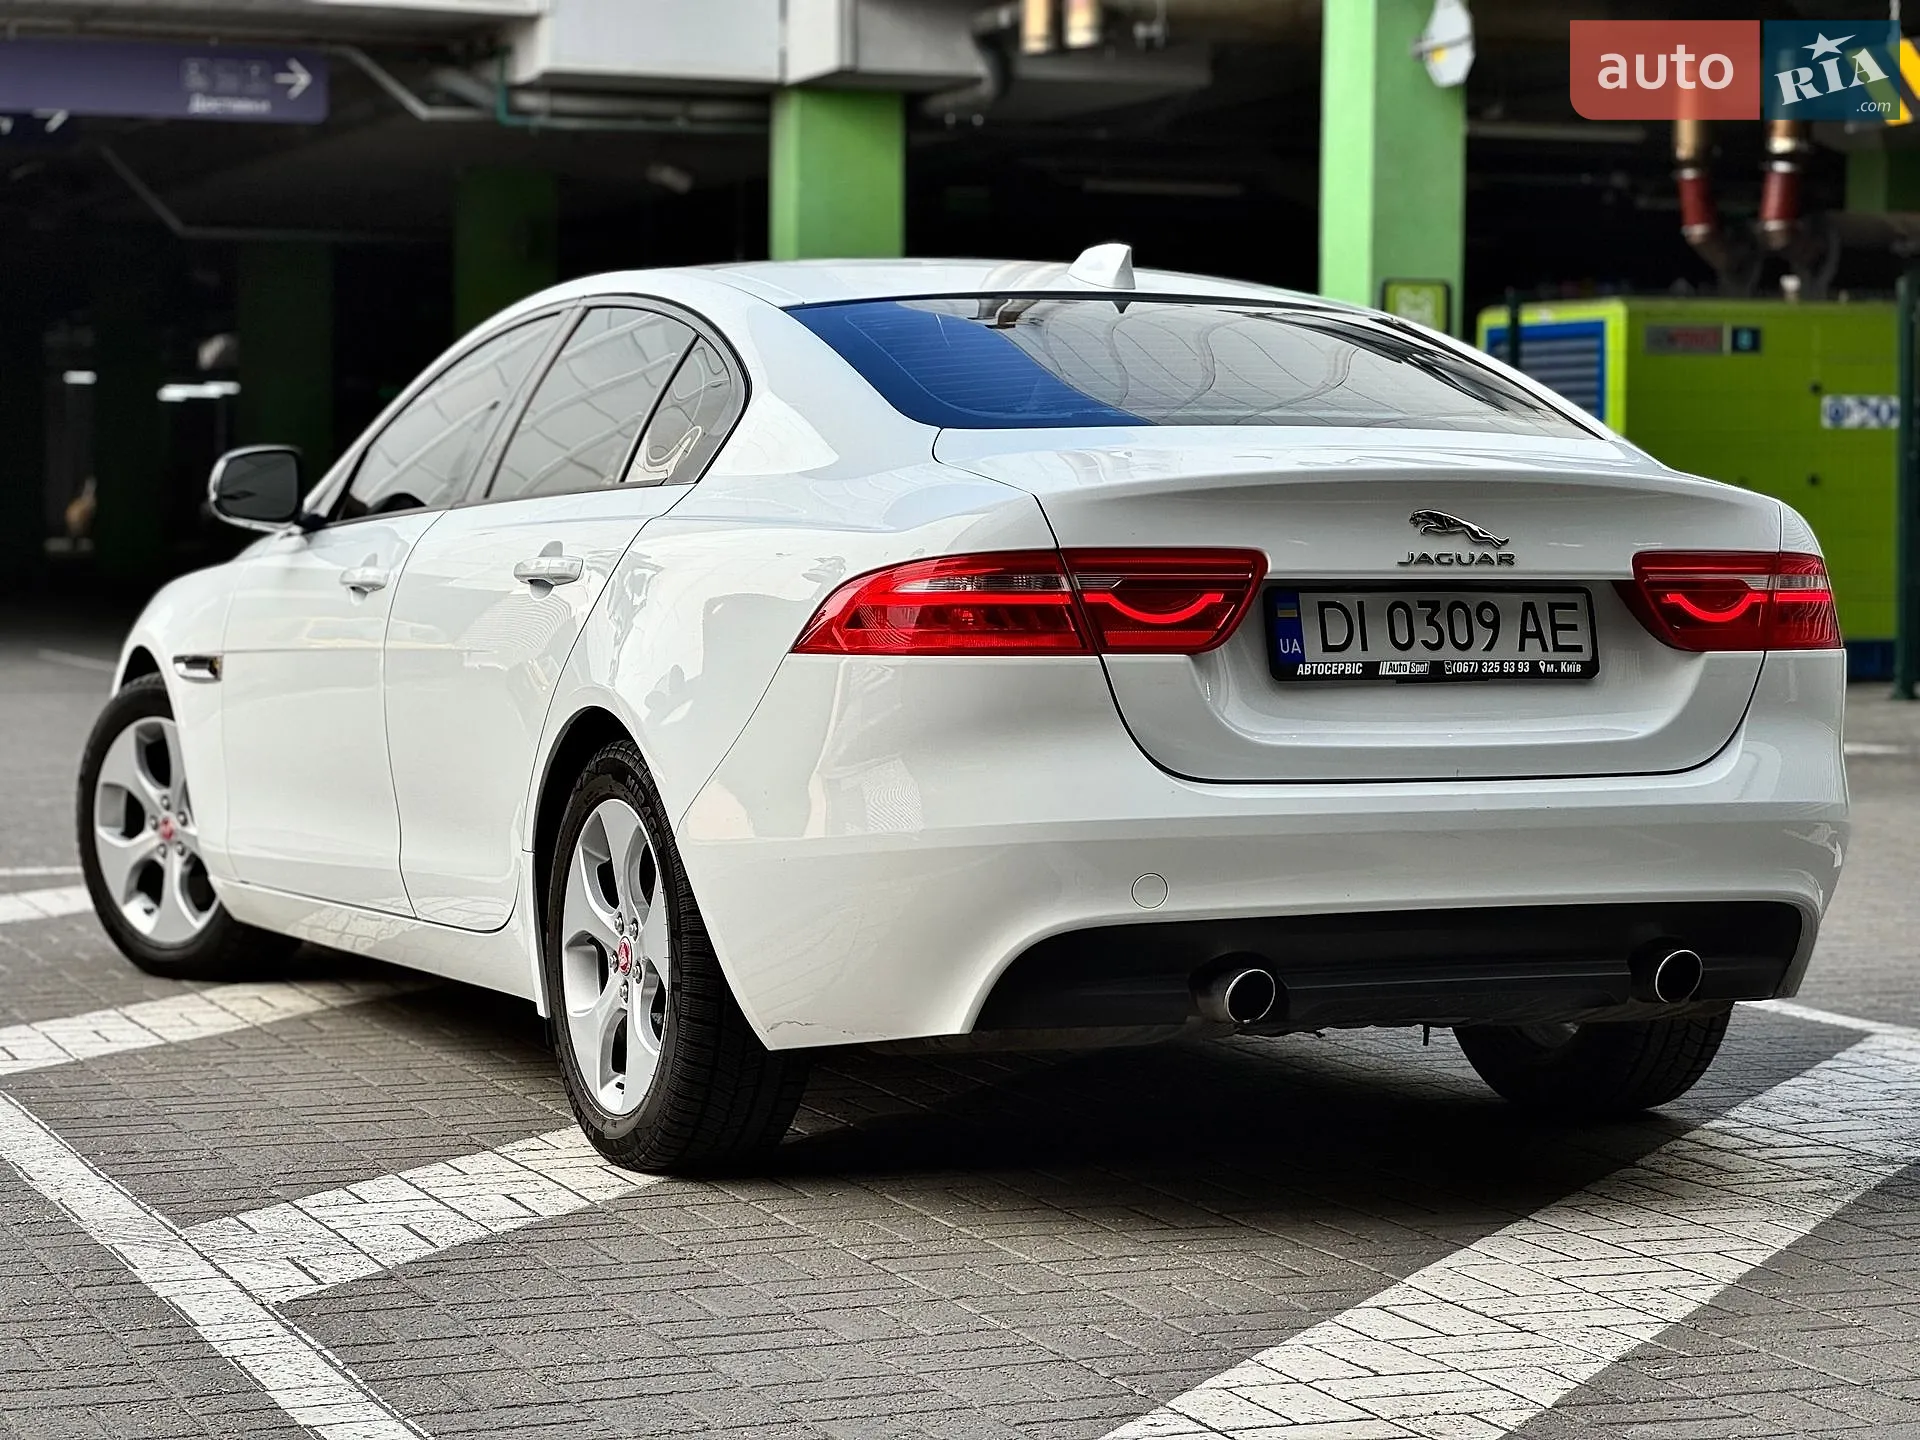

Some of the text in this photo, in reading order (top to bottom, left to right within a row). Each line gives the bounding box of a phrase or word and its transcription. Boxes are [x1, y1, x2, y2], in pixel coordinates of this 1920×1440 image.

[1397, 551, 1516, 566] JAGUAR
[1317, 600, 1584, 653] DI 0309 AE
[1280, 638, 1302, 654] UA
[1297, 661, 1582, 675] АВТОСЕРВІС Auto Spot (067) 325 93 93 м. Київ
